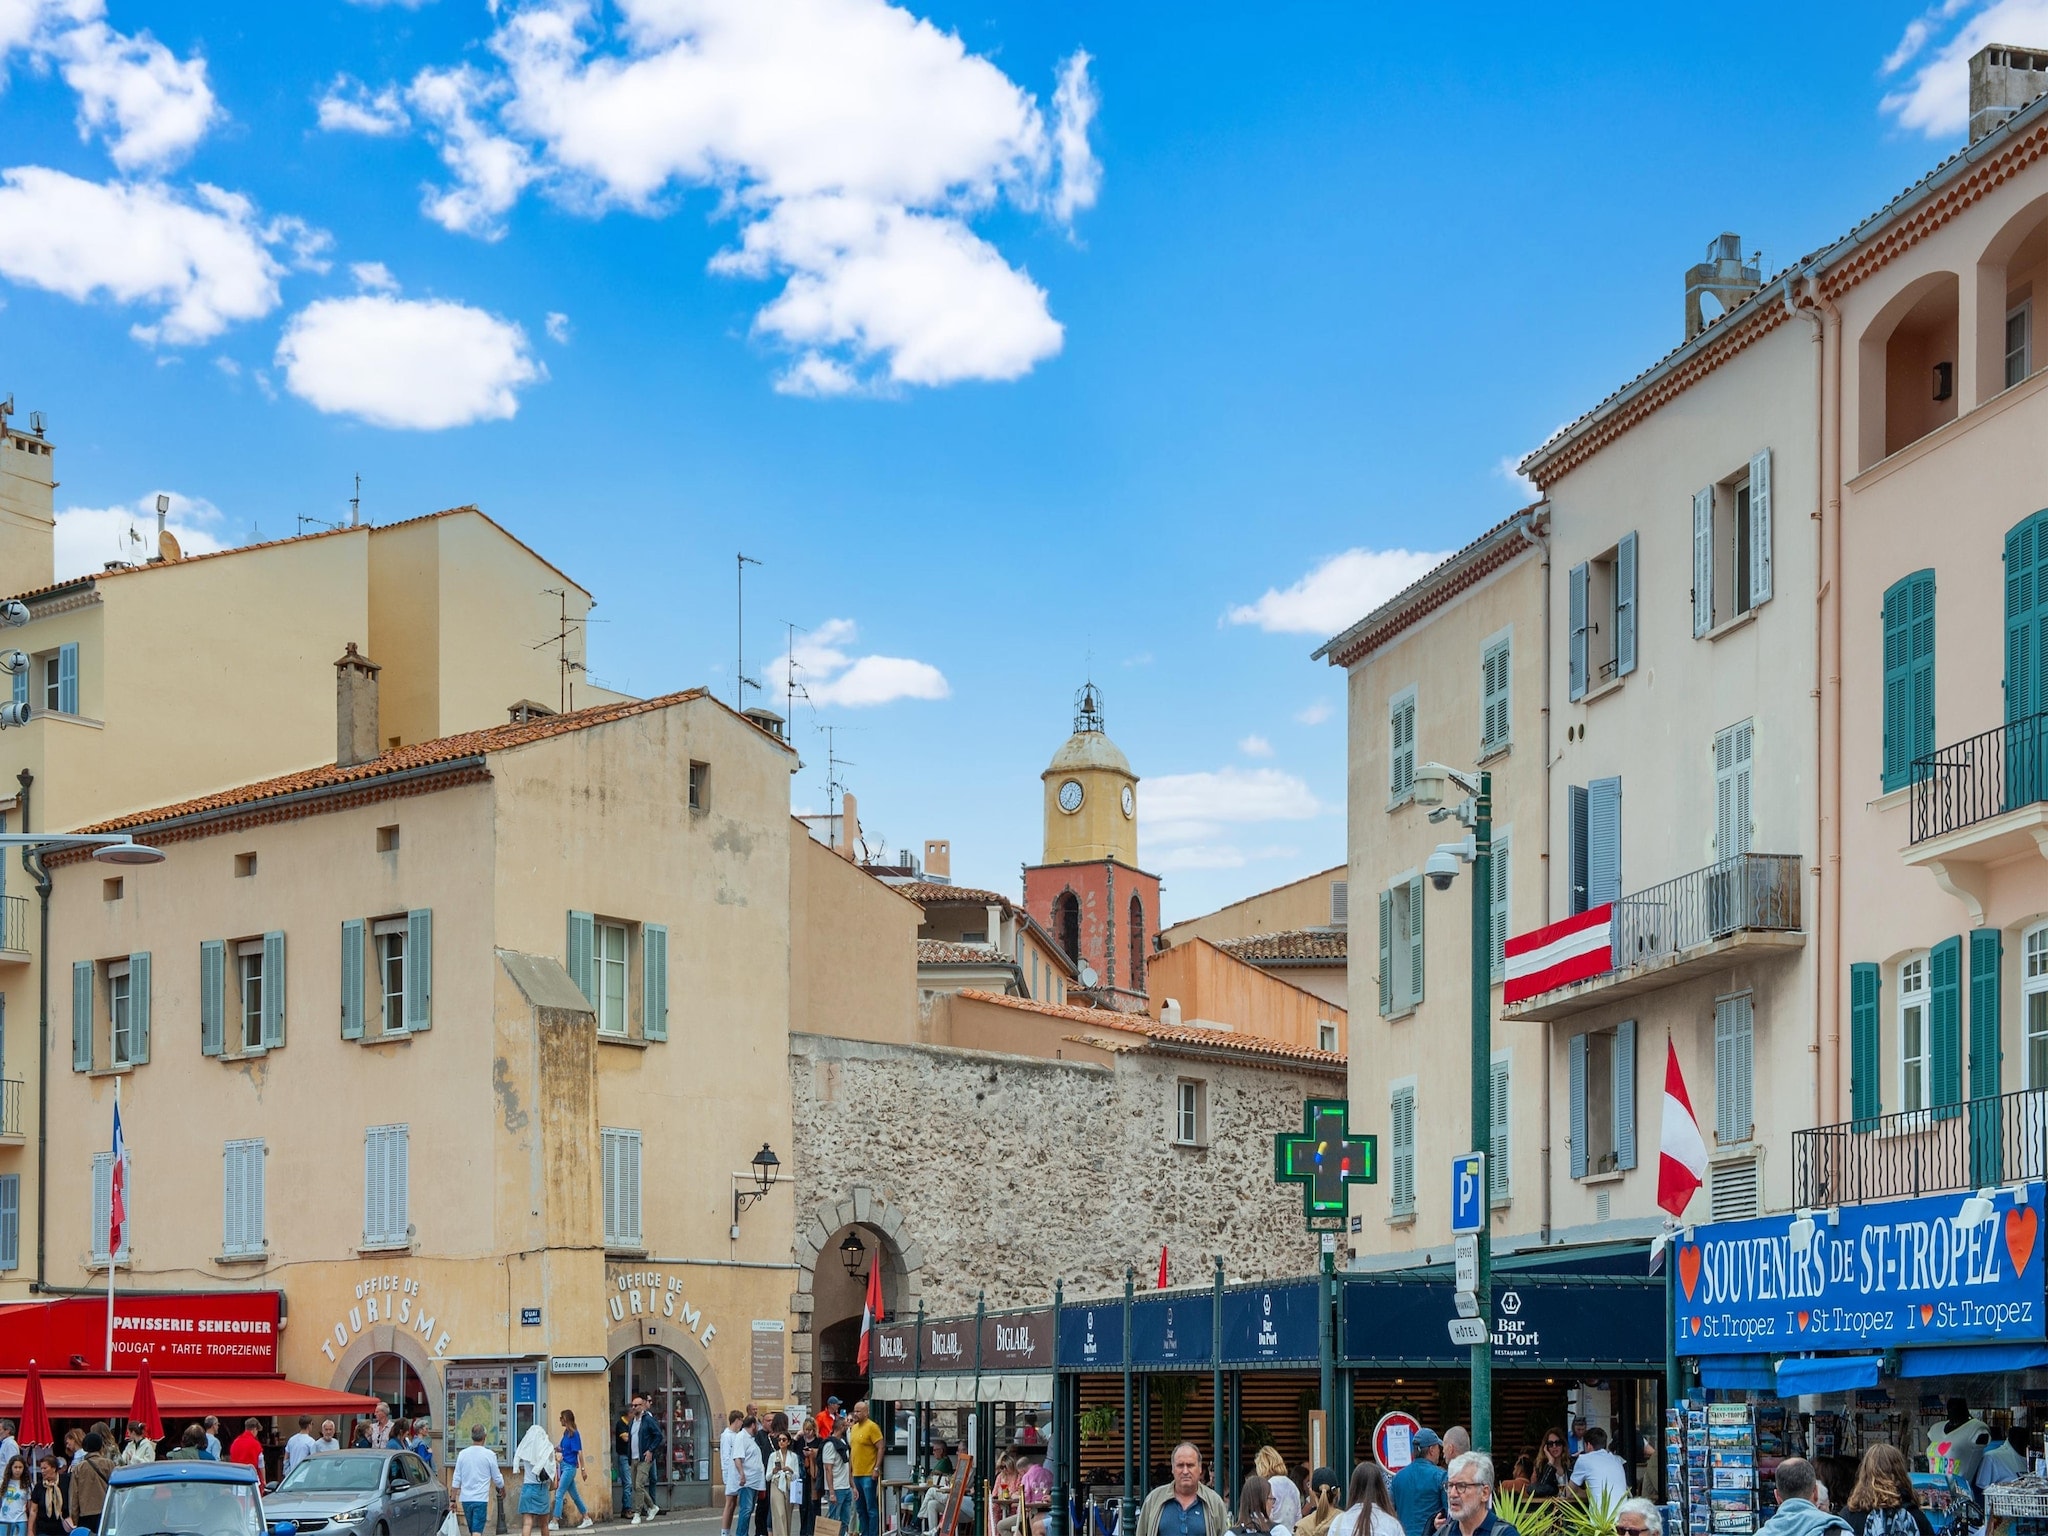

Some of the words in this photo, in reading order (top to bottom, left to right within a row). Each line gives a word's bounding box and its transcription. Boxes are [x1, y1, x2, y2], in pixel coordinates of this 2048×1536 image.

[1460, 1172, 1473, 1217] P
[1703, 1229, 1825, 1305] SOUVENIRS
[1830, 1239, 1855, 1283] DE
[1860, 1211, 2001, 1295] ST-TROPEZ
[355, 1275, 399, 1300] OFFICE
[404, 1277, 419, 1297] DE
[618, 1271, 661, 1291] OFFICE
[668, 1275, 683, 1294] DE
[112, 1316, 194, 1331] PATISSERIE
[198, 1319, 271, 1333] SENEQUIER
[321, 1293, 451, 1362] TOURISME
[604, 1289, 717, 1349] URISME
[1498, 1318, 1525, 1332] Bar
[1681, 1317, 1688, 1338] I
[1703, 1315, 1720, 1337] St
[1722, 1314, 1775, 1343] Tropez
[1786, 1311, 1794, 1334] I
[1811, 1308, 1830, 1333] St
[1833, 1307, 1894, 1338] Tropez
[1907, 1304, 1916, 1329] I
[1937, 1301, 1958, 1328] St
[1961, 1300, 2033, 1332] Tropez
[1454, 1325, 1478, 1338] HÔTEL
[1506, 1331, 1540, 1346] Port
[111, 1341, 155, 1354] NOUGAT
[171, 1343, 202, 1355] TARTE
[206, 1344, 271, 1356] TROPEZIENNE
[554, 1361, 588, 1369] Gendarmerie
